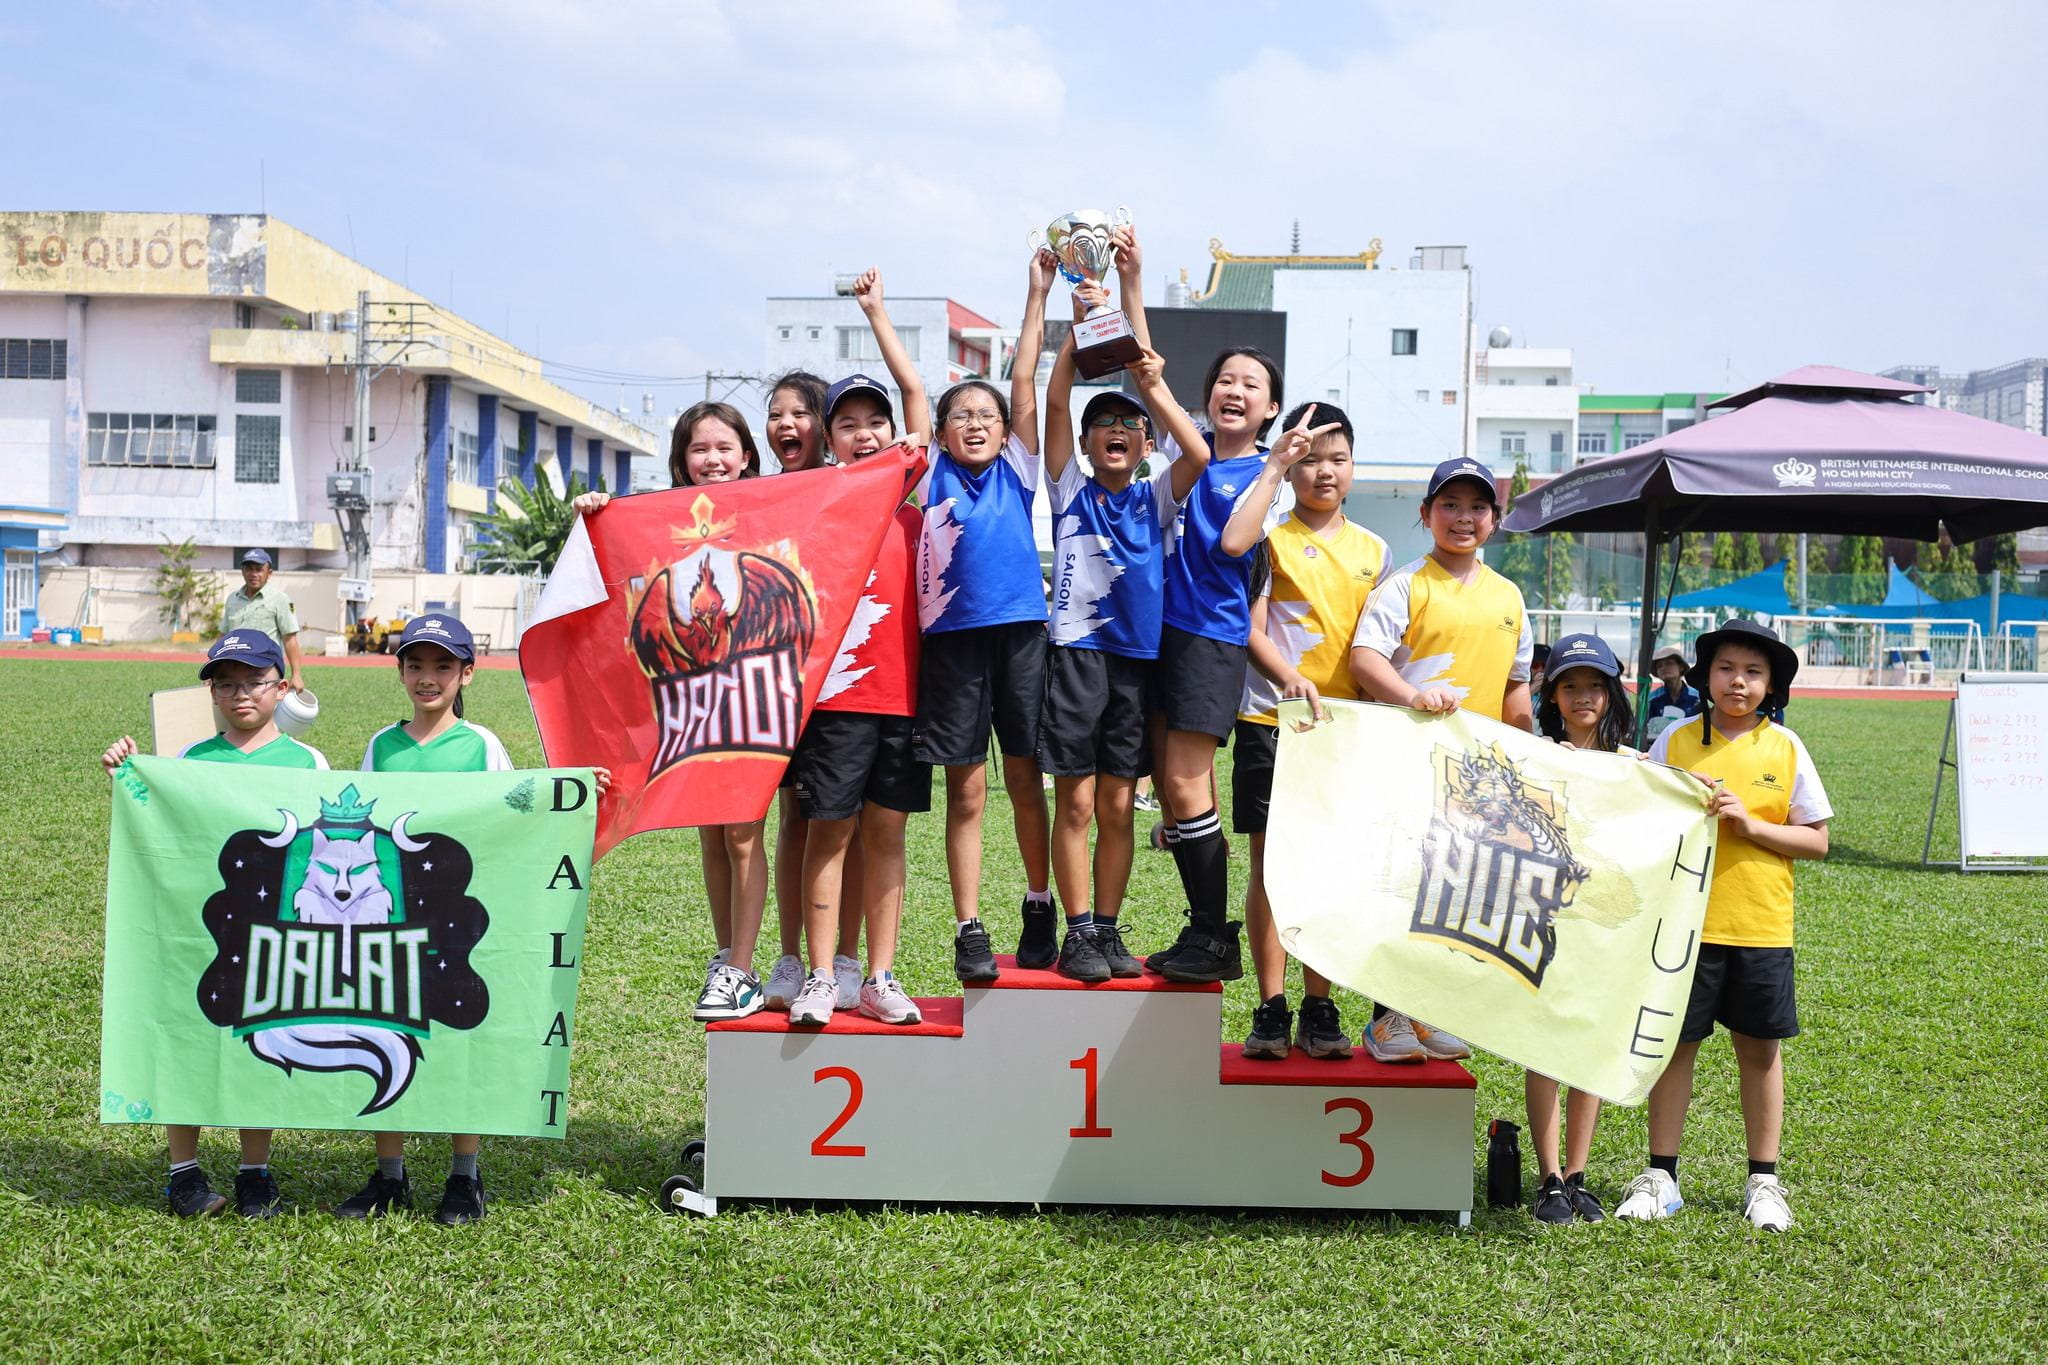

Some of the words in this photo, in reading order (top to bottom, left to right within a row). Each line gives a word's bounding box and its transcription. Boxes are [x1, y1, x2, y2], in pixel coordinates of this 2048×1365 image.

[1820, 459, 1860, 469] BRITISH
[1862, 459, 1929, 470] VIETNAMESE
[1930, 462, 2013, 477] INTERNATIONAL
[2015, 469, 2048, 480] SCHOO
[1821, 470, 1838, 478] HO
[1840, 470, 1858, 478] CHI
[1860, 470, 1889, 479] MINH
[1890, 470, 1914, 479] CITY
[1922, 482, 1952, 491] SCHOOL
[922, 531, 930, 595] SAIGON
[1057, 552, 1076, 611] SAIGON
[650, 649, 798, 775] HANOI
[1419, 826, 1557, 974] HUE
[241, 923, 430, 1022] DALAT
[541, 777, 588, 1126] DALAT
[1630, 834, 1712, 1058] HUE
[811, 1066, 866, 1157] 2
[1069, 1048, 1112, 1138] 1
[1321, 1098, 1375, 1187] 3
